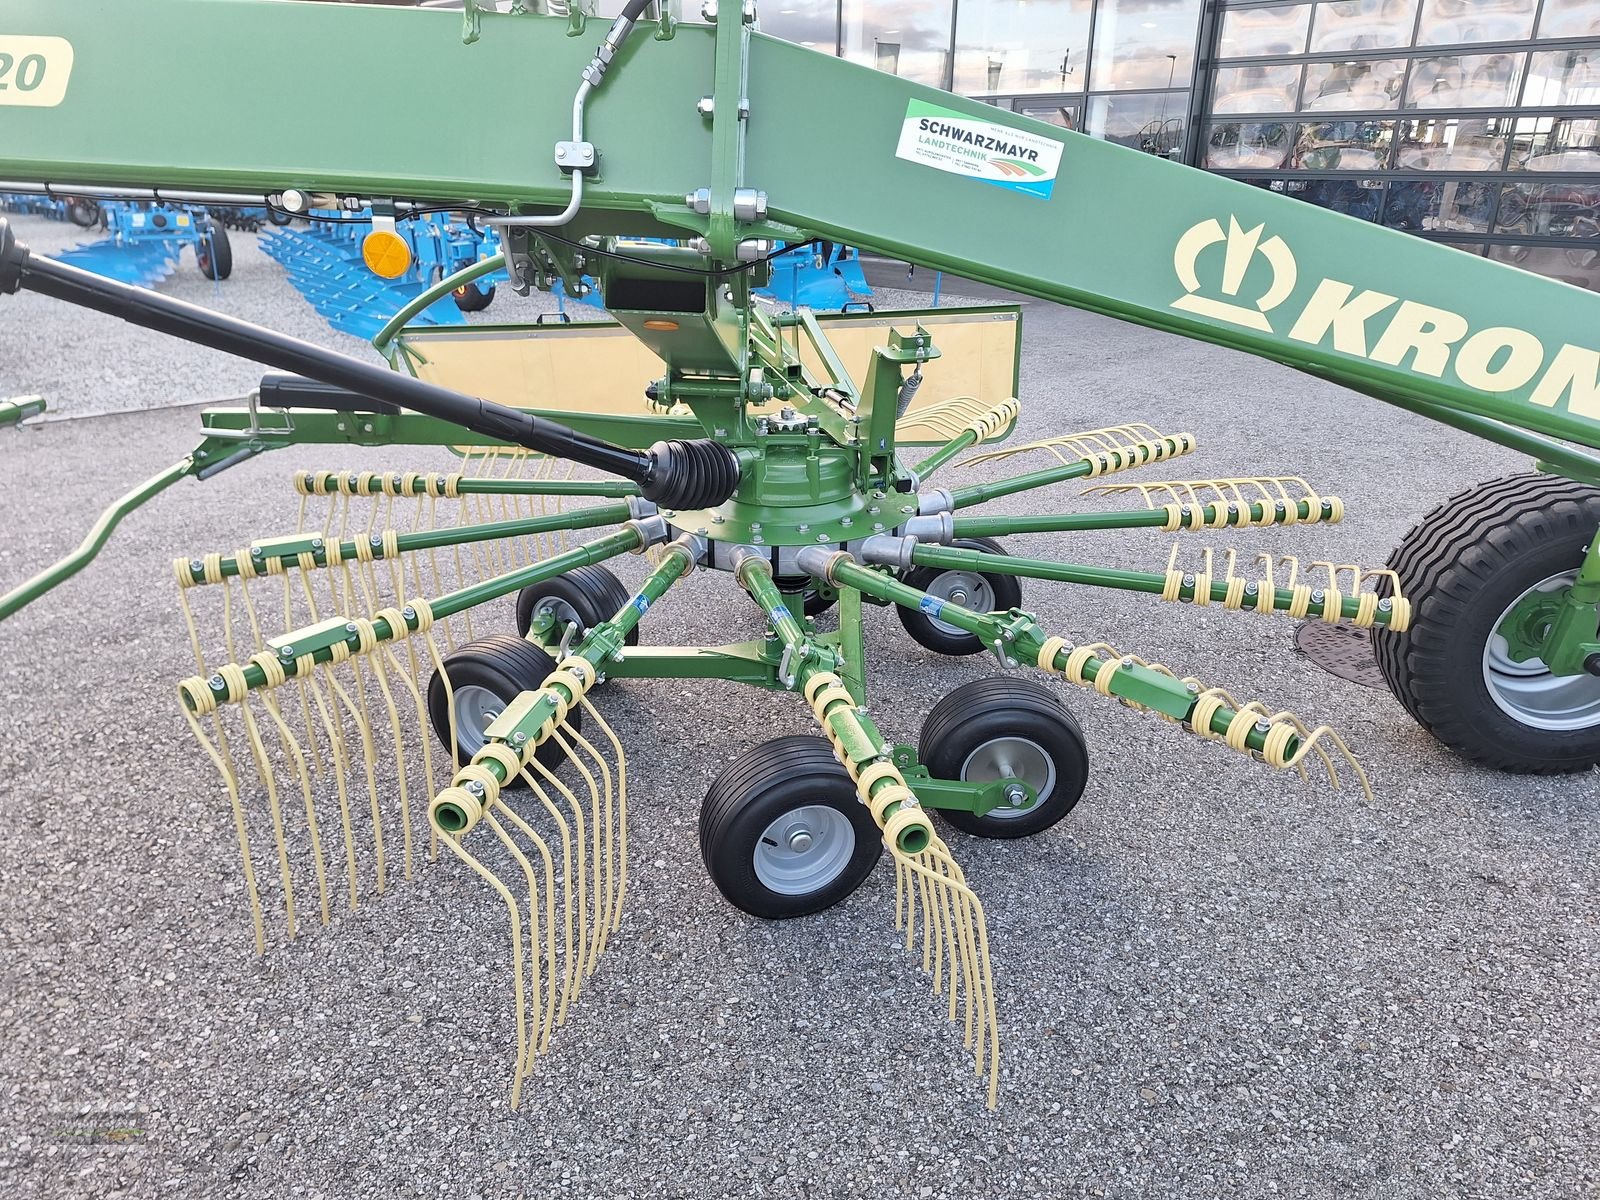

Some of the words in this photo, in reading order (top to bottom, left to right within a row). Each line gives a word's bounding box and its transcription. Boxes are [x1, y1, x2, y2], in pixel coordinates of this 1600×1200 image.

[918, 134, 988, 161] LANDTECHNIK
[919, 118, 1039, 163] SCHWARZMAYR
[1287, 278, 1600, 422] KRON
